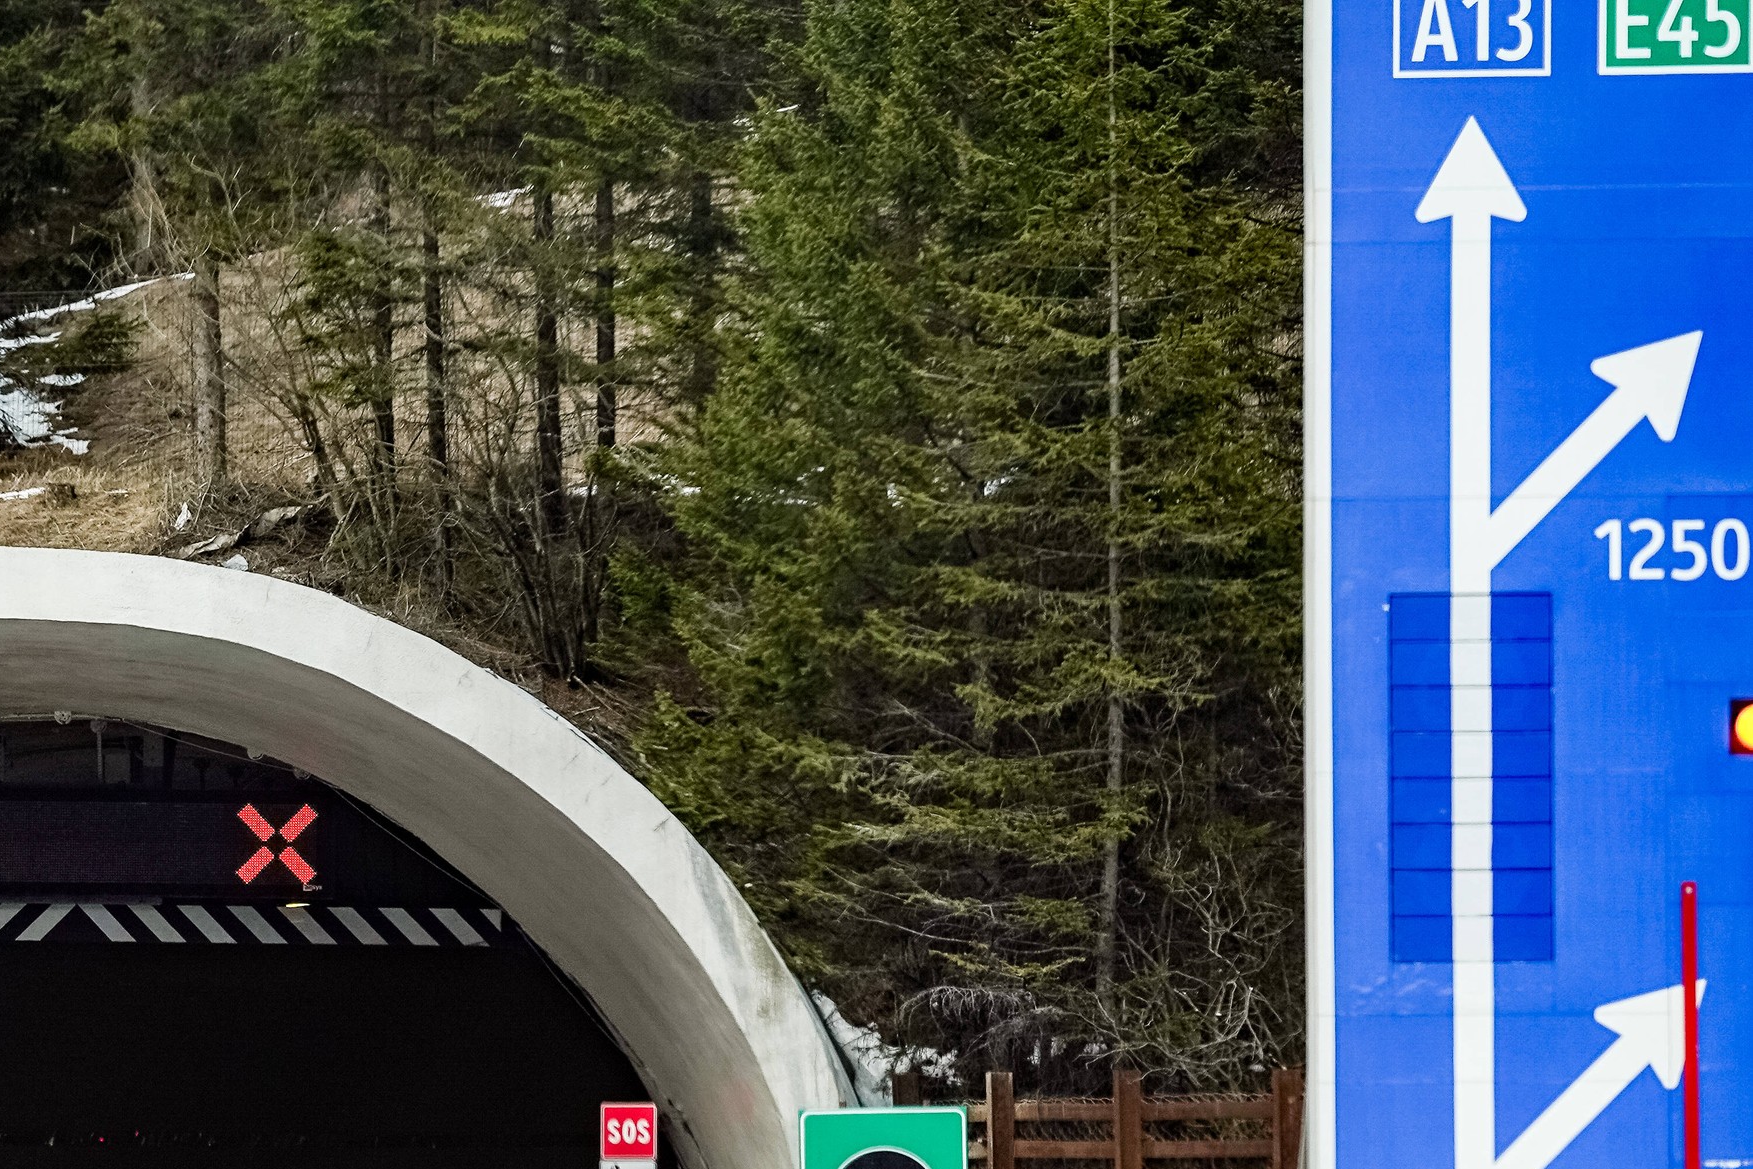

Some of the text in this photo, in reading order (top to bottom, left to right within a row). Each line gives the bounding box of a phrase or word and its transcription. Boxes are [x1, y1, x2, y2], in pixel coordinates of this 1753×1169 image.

[1411, 0, 1534, 62] A13
[1615, 0, 1742, 59] E45
[1594, 517, 1751, 582] 1250
[607, 1117, 651, 1145] SOS
